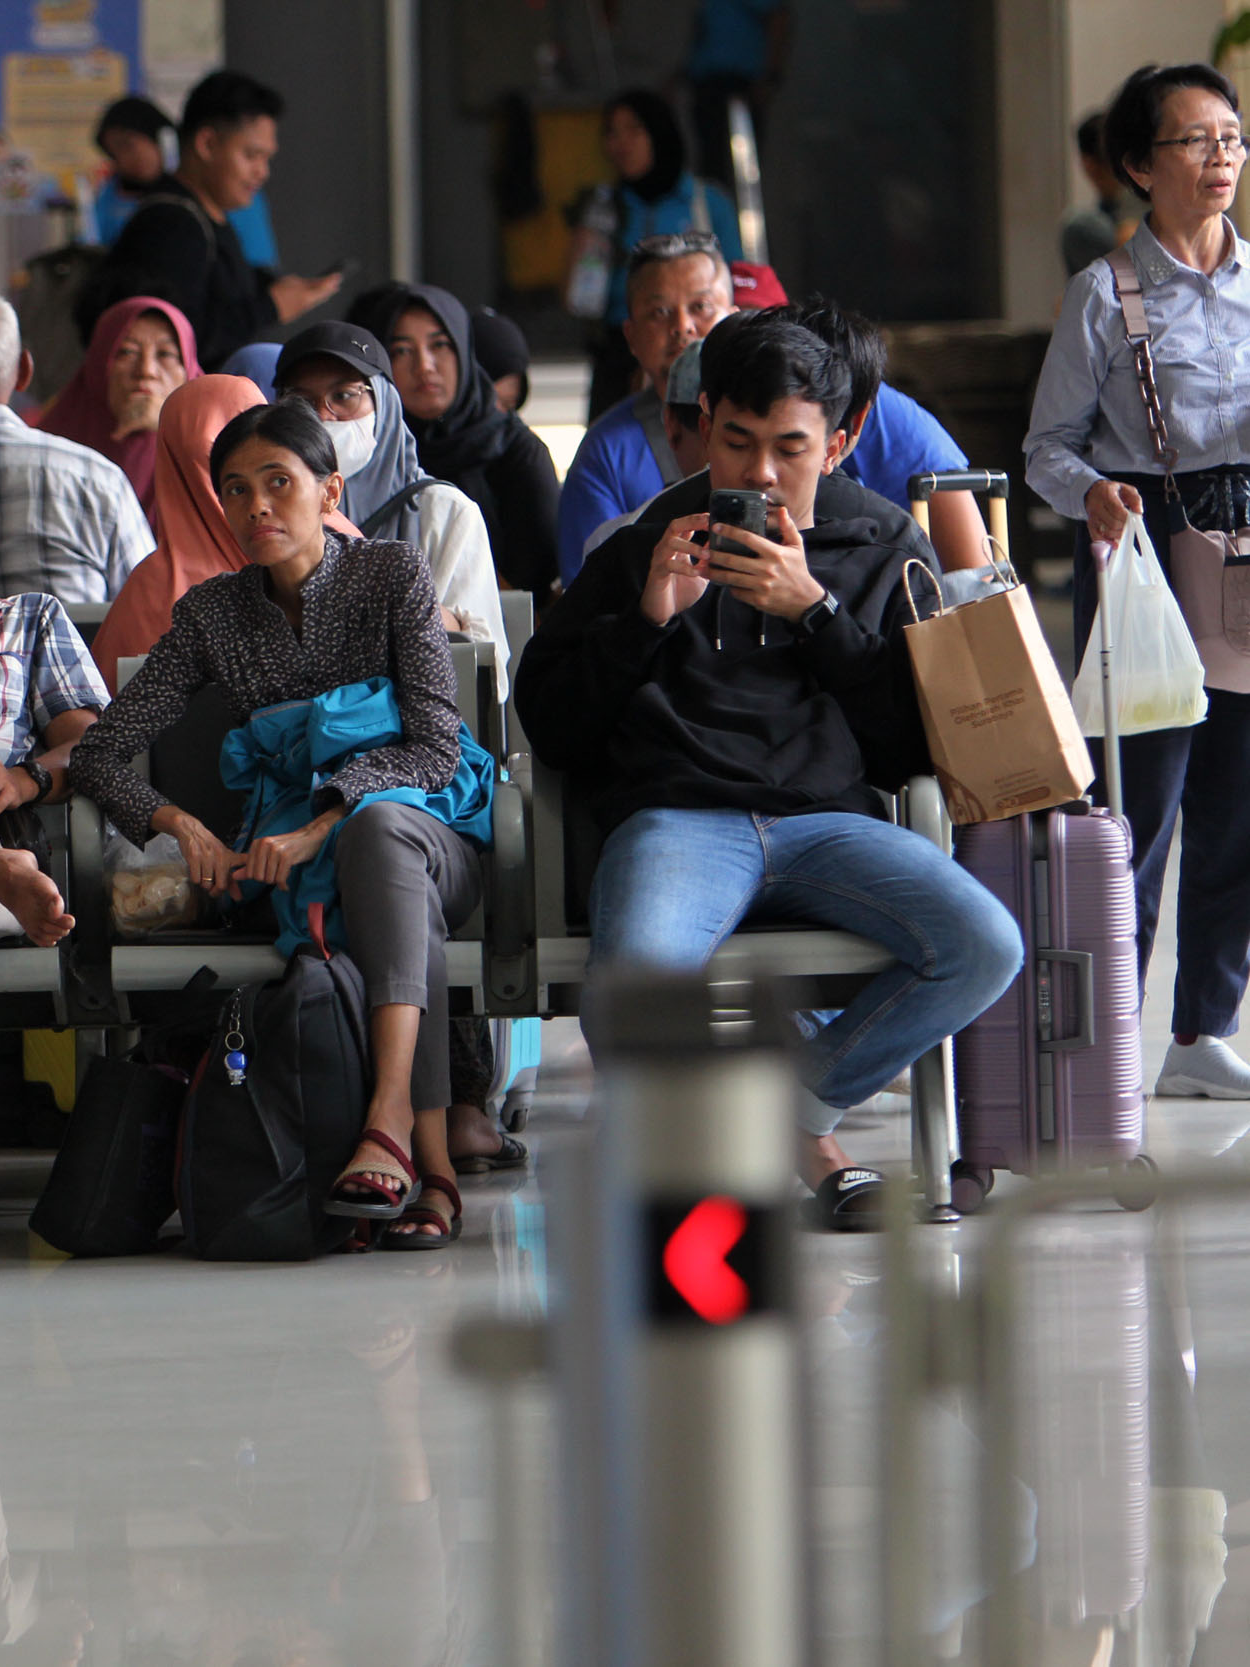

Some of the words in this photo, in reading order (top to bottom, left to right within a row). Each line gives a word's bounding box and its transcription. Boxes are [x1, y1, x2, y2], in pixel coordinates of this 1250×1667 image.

[950, 702, 982, 717] Pilihan
[984, 688, 1024, 704] Pertama
[972, 710, 1014, 728] Surabaya
